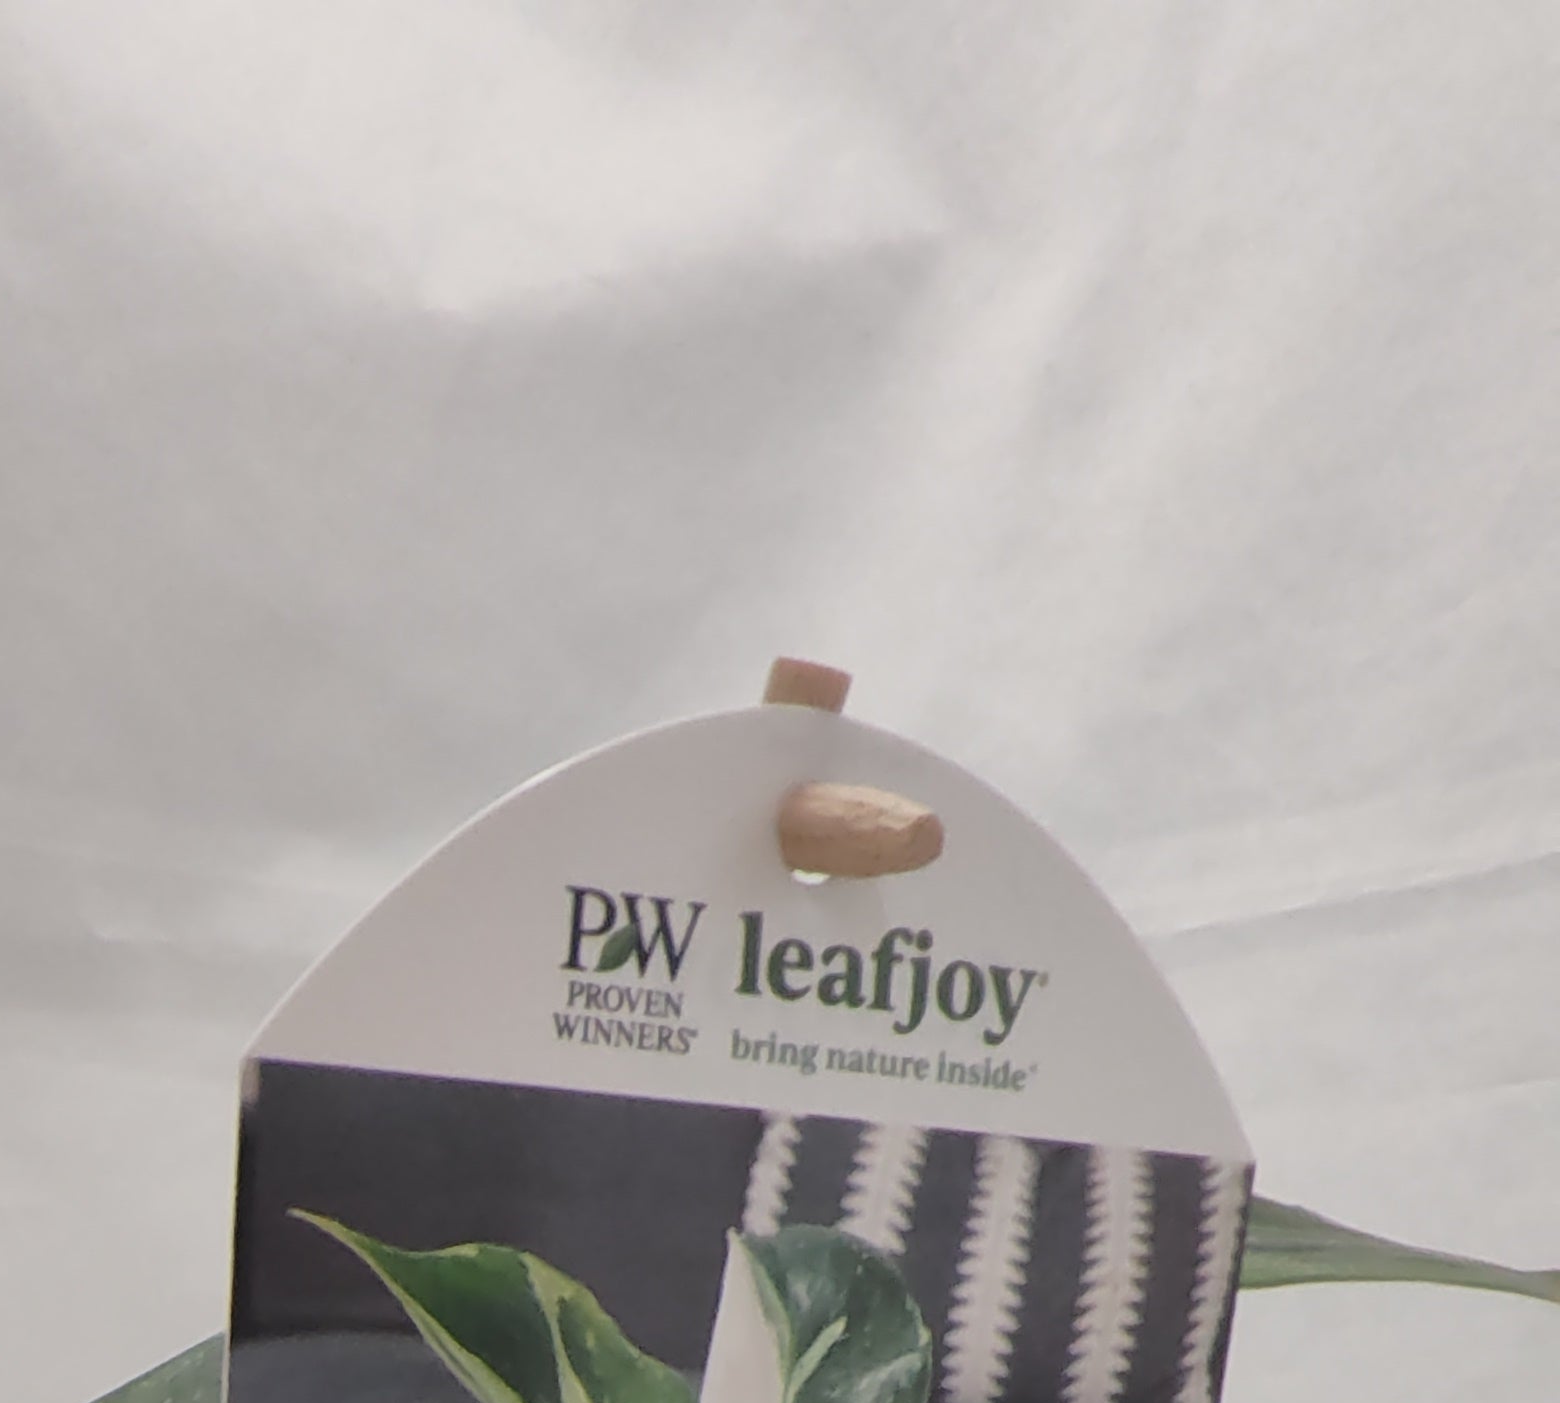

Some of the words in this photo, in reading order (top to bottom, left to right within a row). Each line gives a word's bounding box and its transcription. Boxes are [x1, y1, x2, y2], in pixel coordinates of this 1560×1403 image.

[567, 980, 685, 1019] PROVEN
[733, 911, 1041, 1046] leafjoy
[731, 1028, 816, 1075] bring
[825, 1044, 931, 1081] nature
[936, 1051, 1030, 1092] inside
